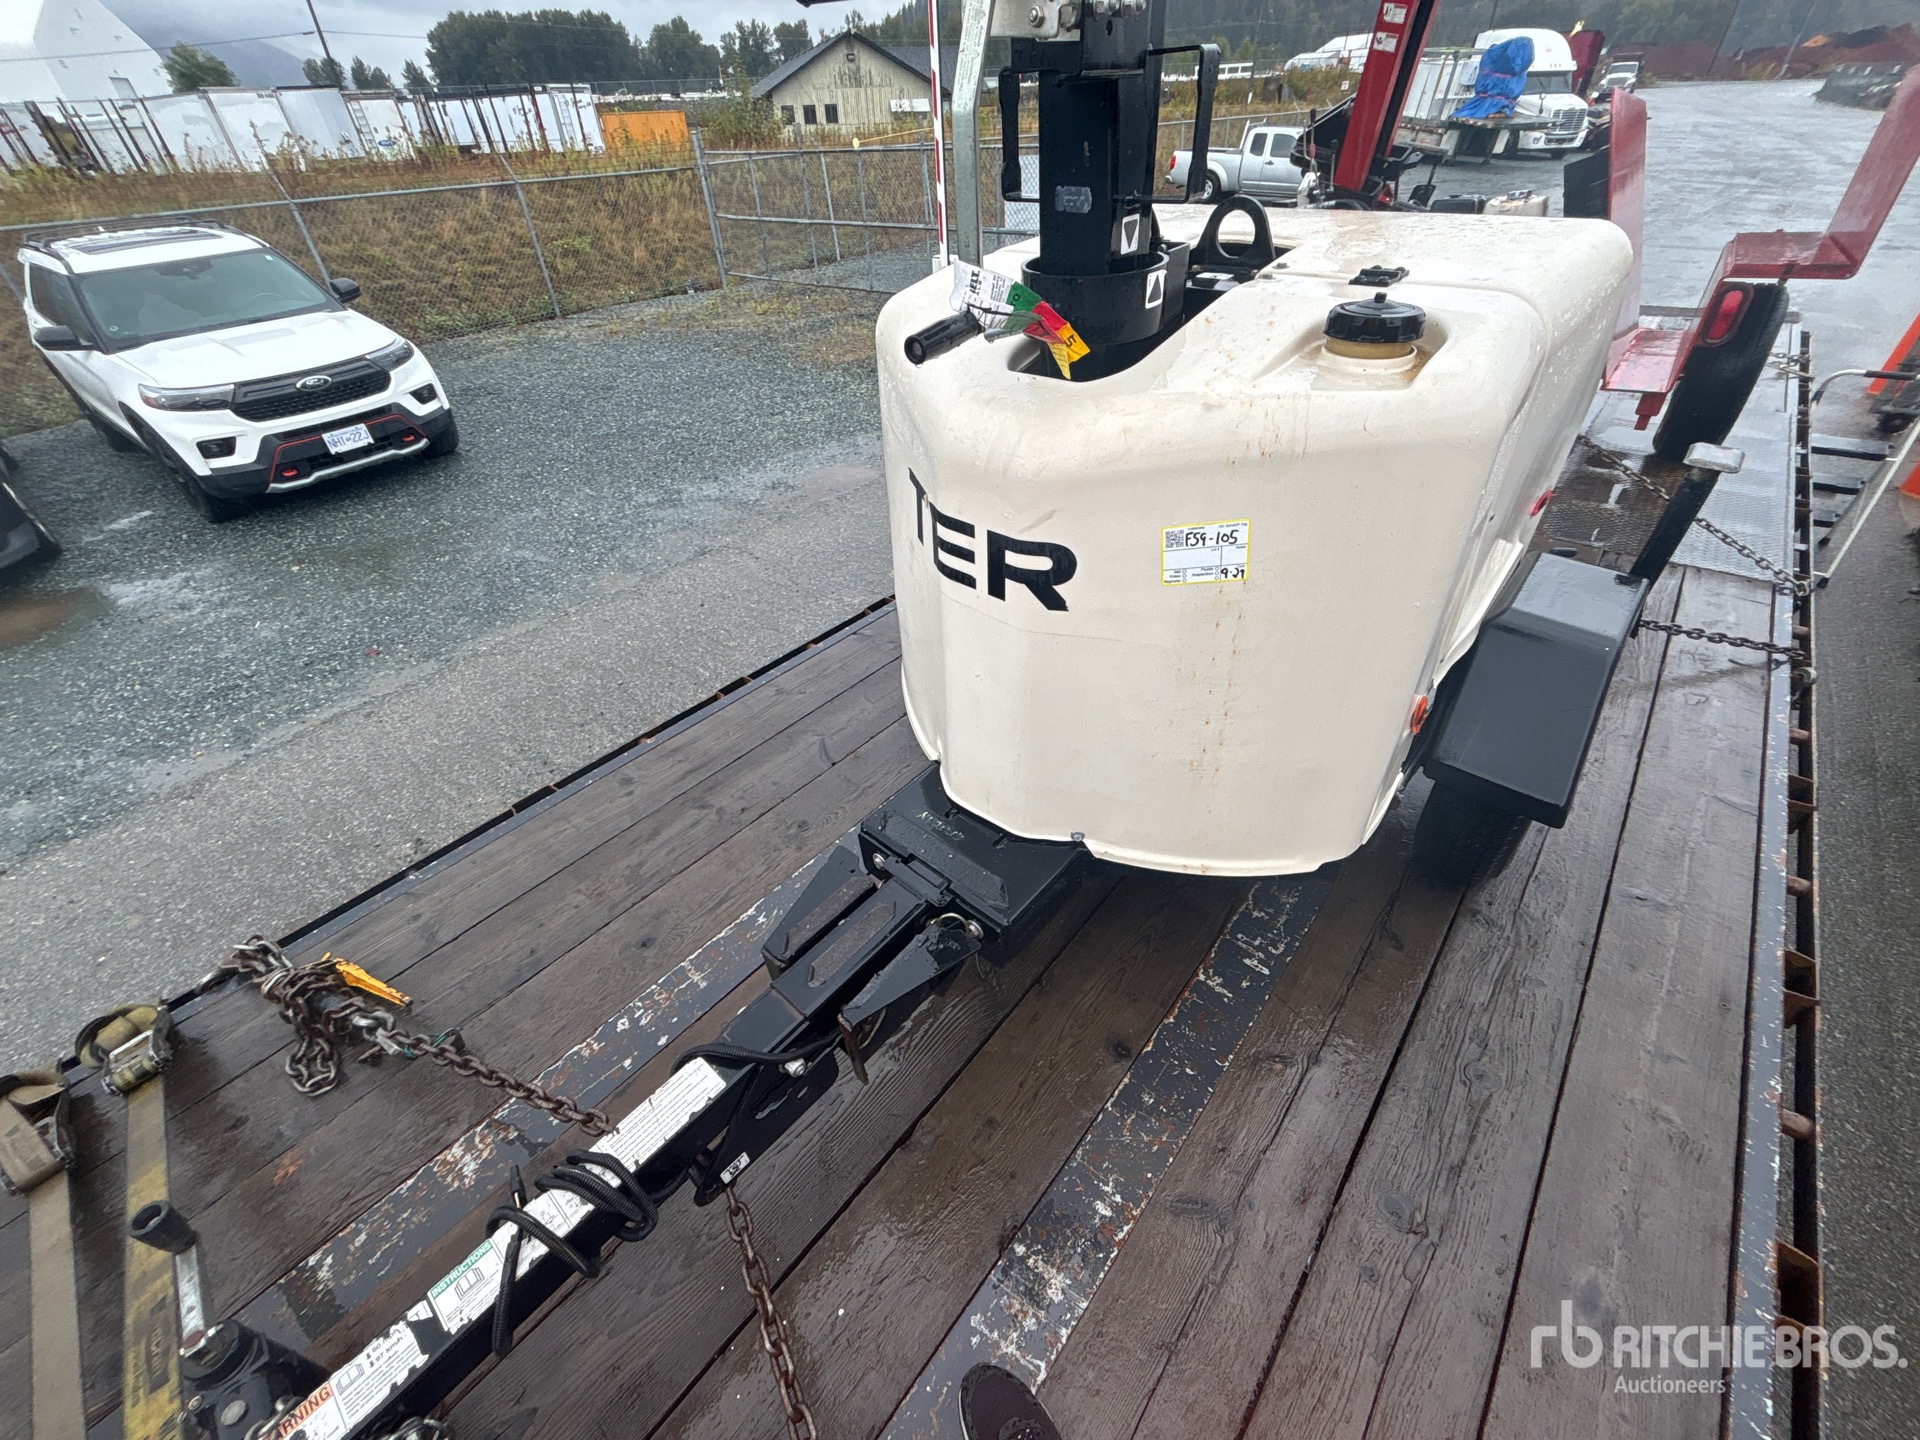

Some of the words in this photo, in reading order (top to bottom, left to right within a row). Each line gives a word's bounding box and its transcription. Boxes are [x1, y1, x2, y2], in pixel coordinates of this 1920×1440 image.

[908, 467, 1078, 612] TER
[431, 1240, 492, 1298] INSTRUCTIONS
[272, 1387, 330, 1440] RNING
